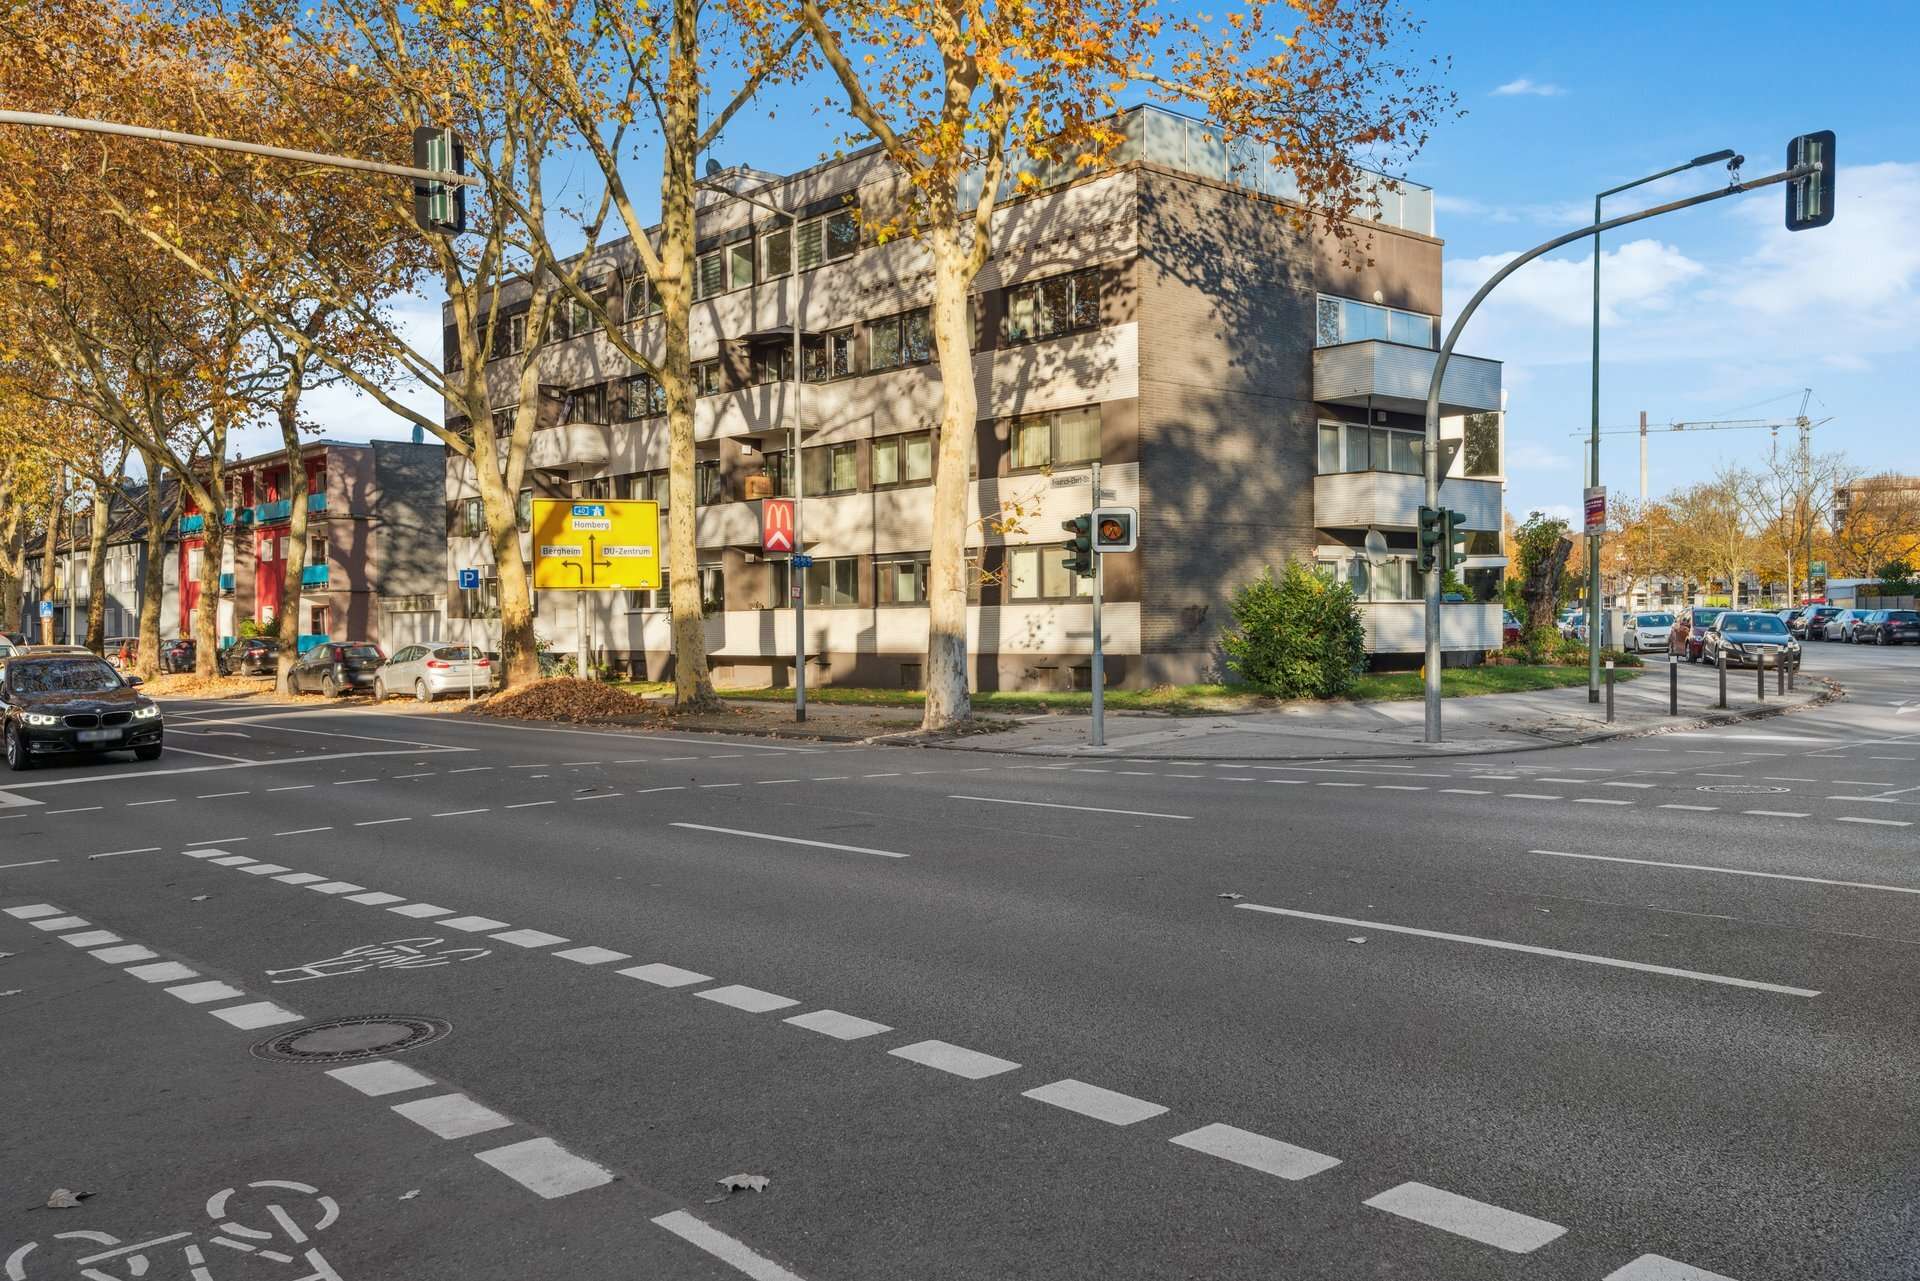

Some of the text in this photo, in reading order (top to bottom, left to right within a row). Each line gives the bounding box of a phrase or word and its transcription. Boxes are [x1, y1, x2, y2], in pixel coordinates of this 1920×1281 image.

[574, 521, 609, 530] Homberg
[542, 547, 581, 556] Bergheim
[603, 547, 650, 555] DU-Zentrum
[463, 571, 475, 586] P
